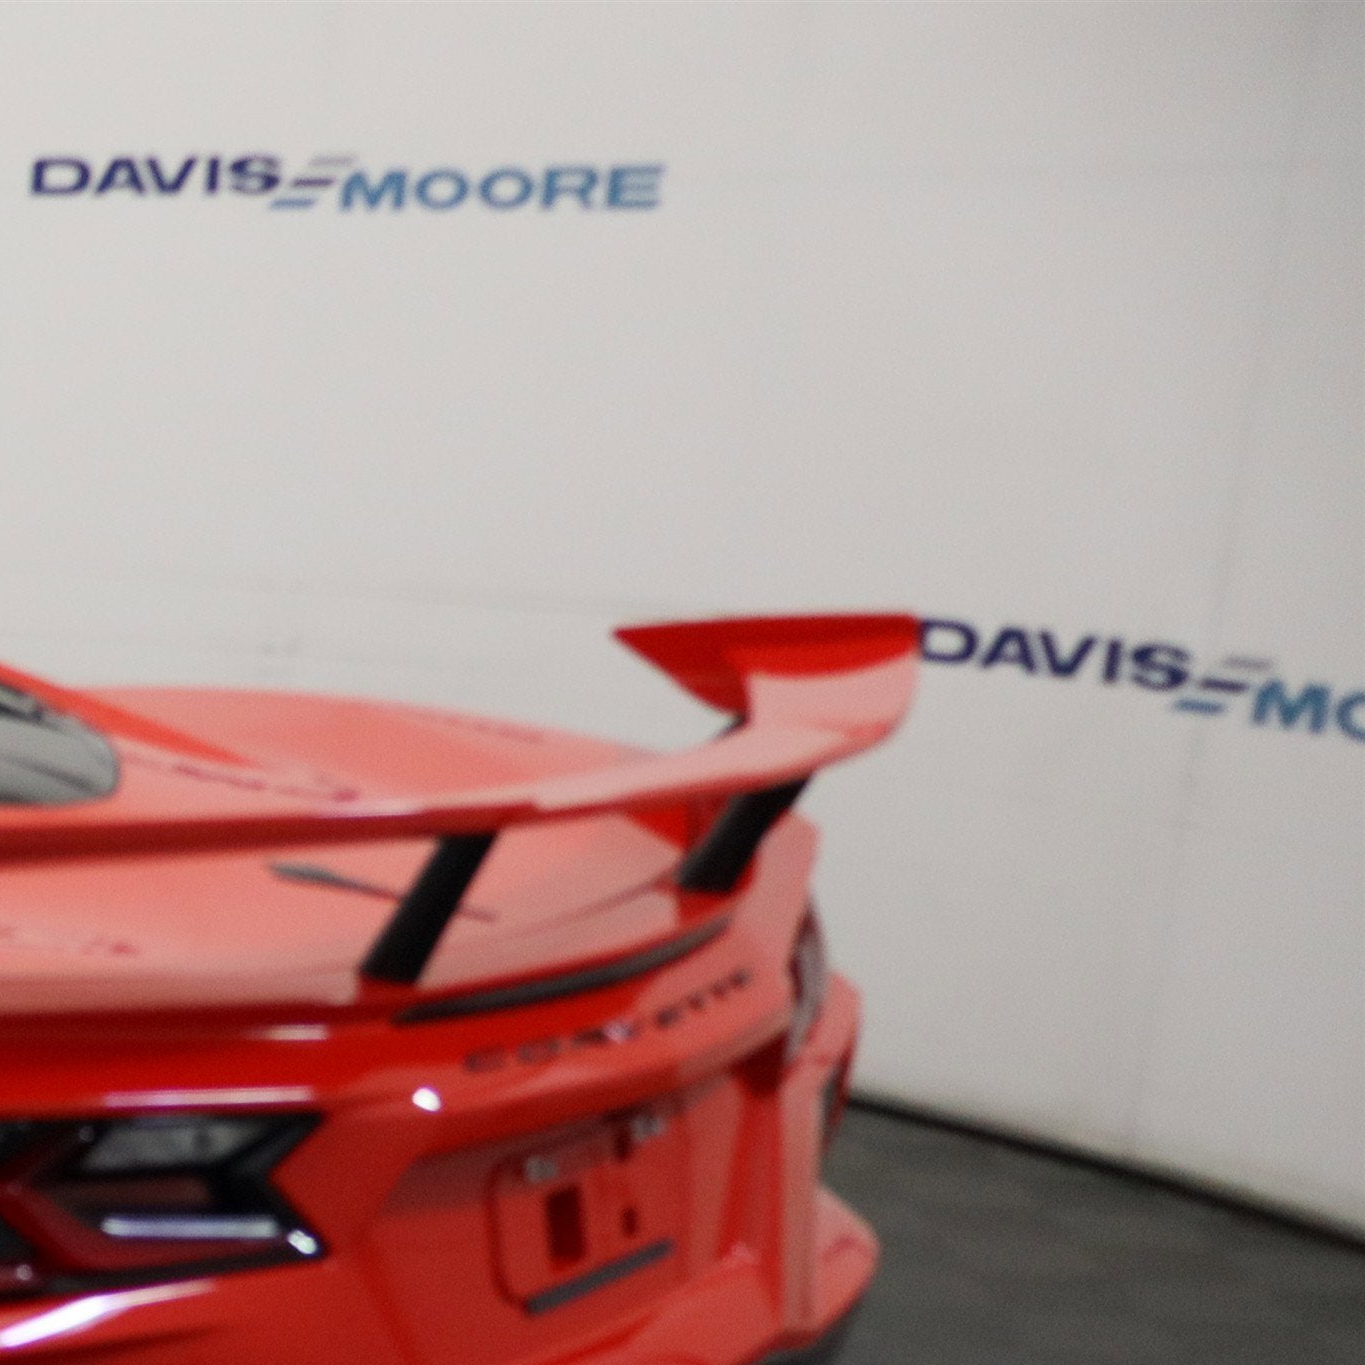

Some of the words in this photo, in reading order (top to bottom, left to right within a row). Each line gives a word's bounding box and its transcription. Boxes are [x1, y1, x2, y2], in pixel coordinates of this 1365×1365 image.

[29, 156, 282, 196] DAVIS
[337, 164, 665, 212] MOORE
[919, 617, 1190, 693] DAVIS
